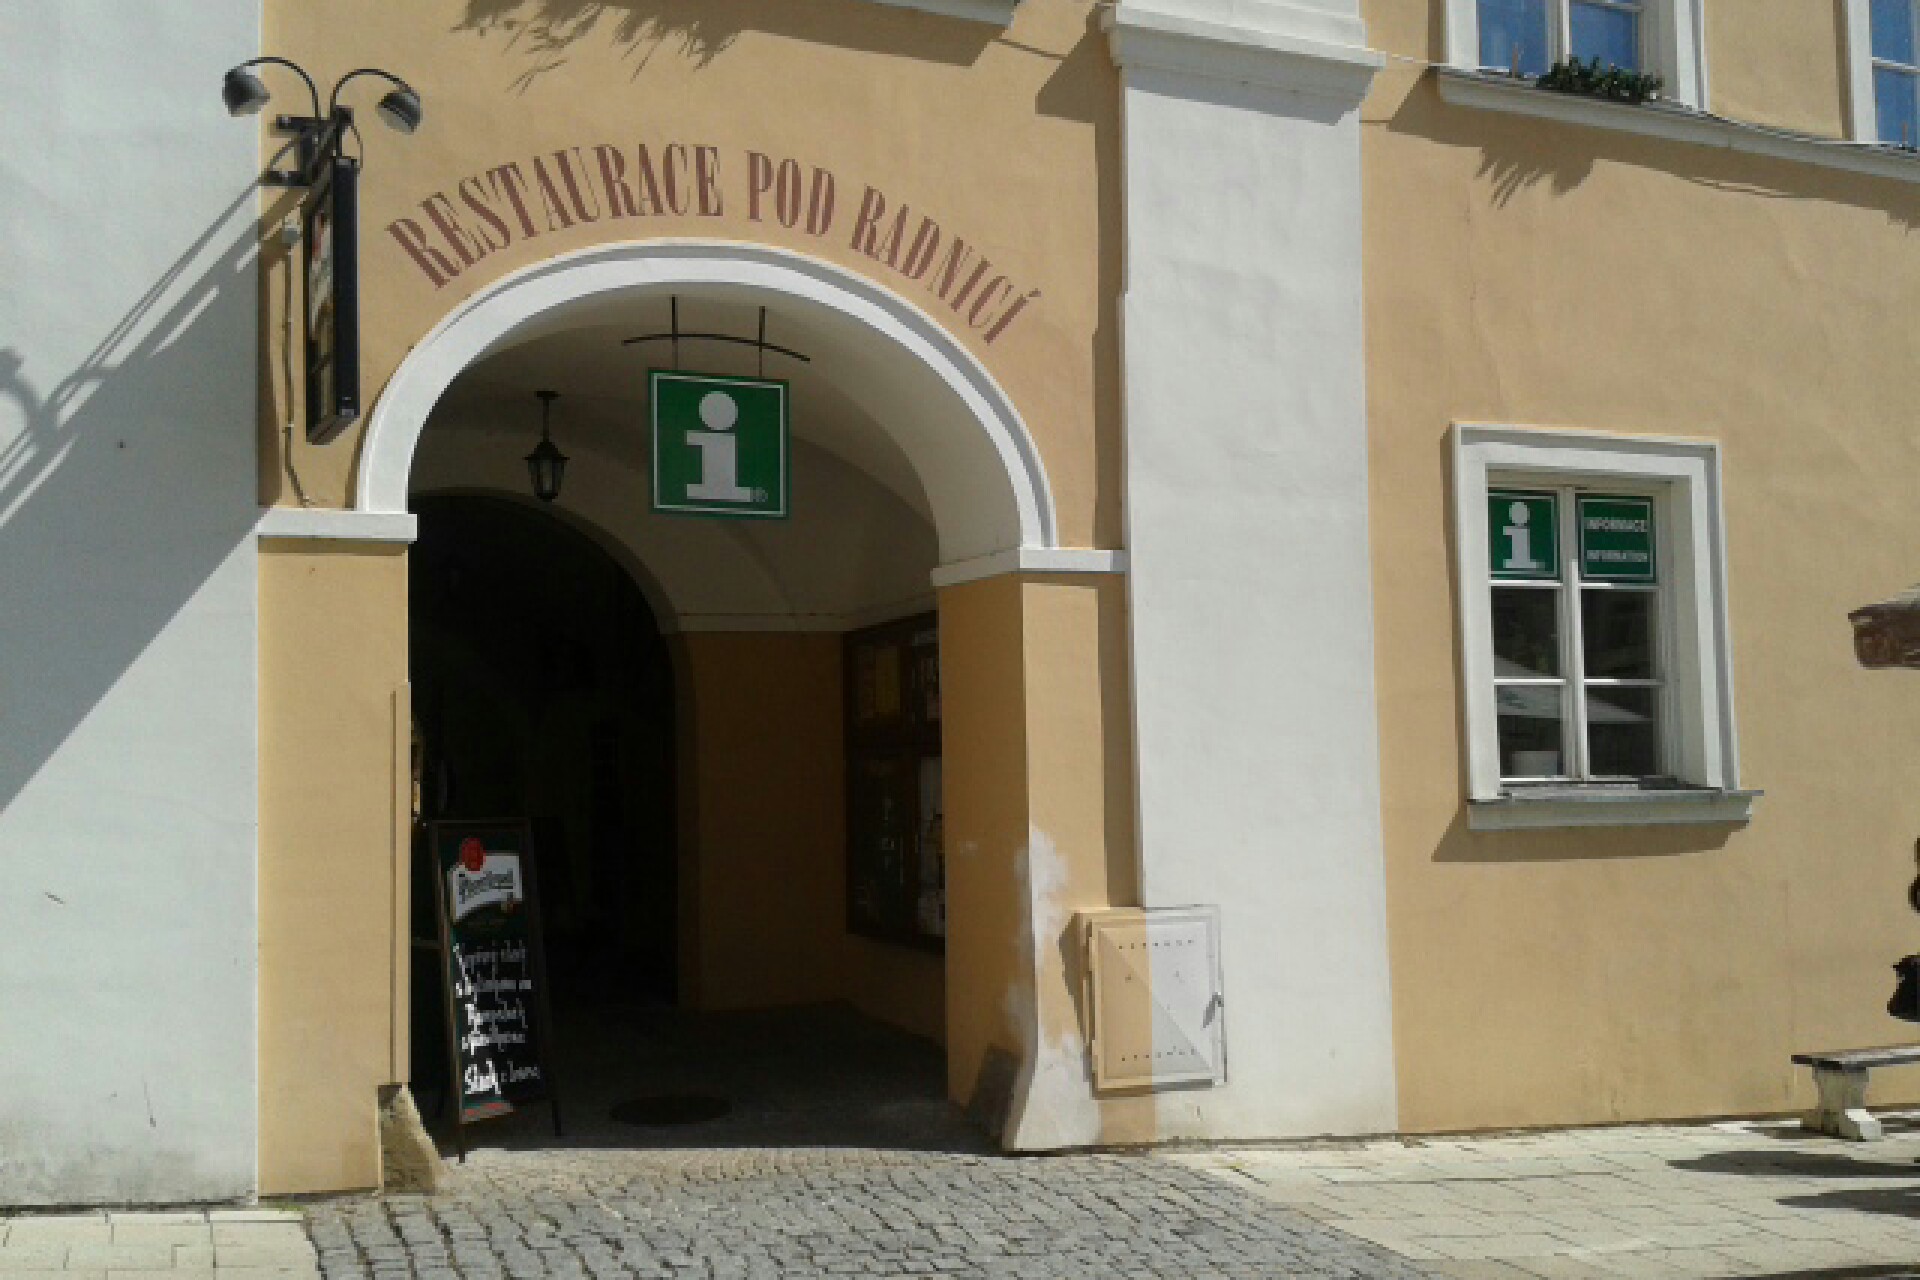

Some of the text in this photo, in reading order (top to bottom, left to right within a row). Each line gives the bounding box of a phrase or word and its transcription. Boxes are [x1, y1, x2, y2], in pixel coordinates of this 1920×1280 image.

[385, 142, 1041, 345] RESTAURACE POD RADNICÍ
